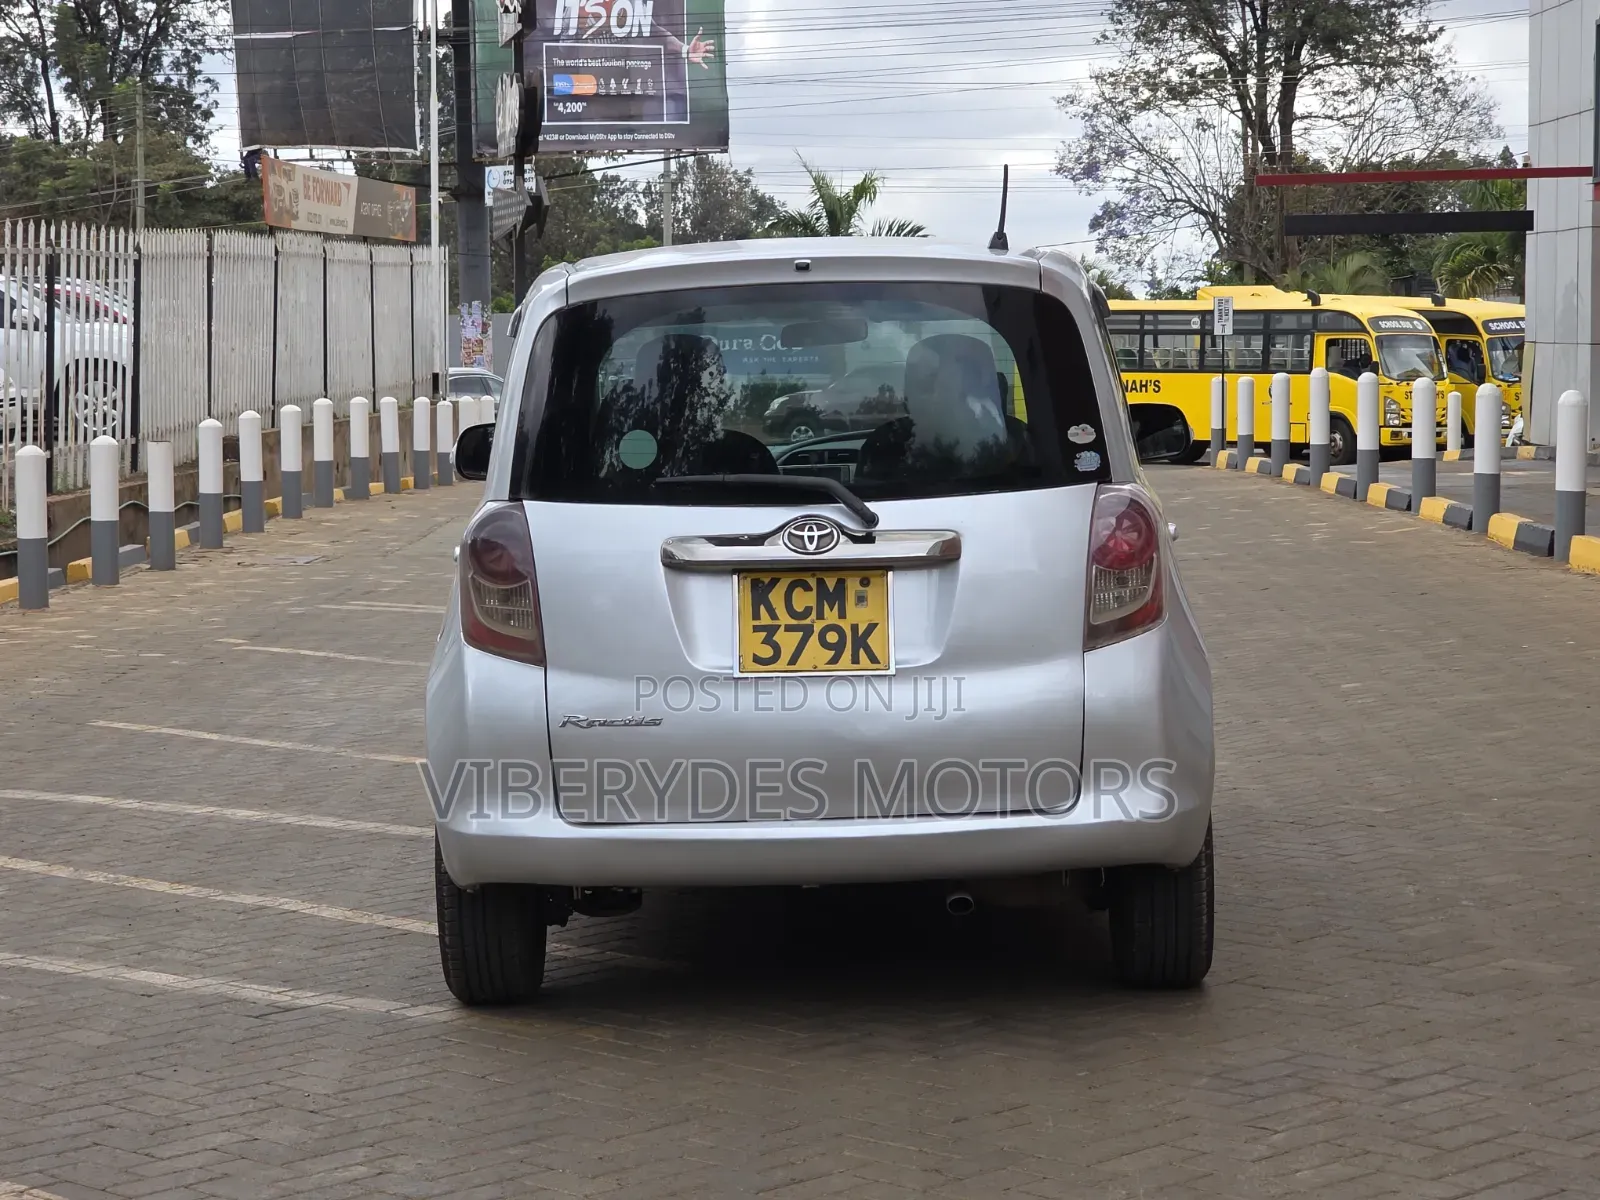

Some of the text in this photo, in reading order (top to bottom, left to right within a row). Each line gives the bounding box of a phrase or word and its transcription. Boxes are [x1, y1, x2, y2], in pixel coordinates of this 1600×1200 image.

[553, 58, 652, 70] The world's best football package
[557, 102, 583, 115] 4,200
[565, 133, 590, 141] Download
[608, 133, 617, 142] App
[624, 133, 634, 142] stay
[303, 173, 342, 207] BE FORWARD
[1378, 320, 1402, 329] SCHOOL
[1488, 321, 1521, 331] SCHOOL
[750, 577, 848, 622] KCM
[751, 622, 882, 667] 379K
[558, 714, 664, 729] Ractis
